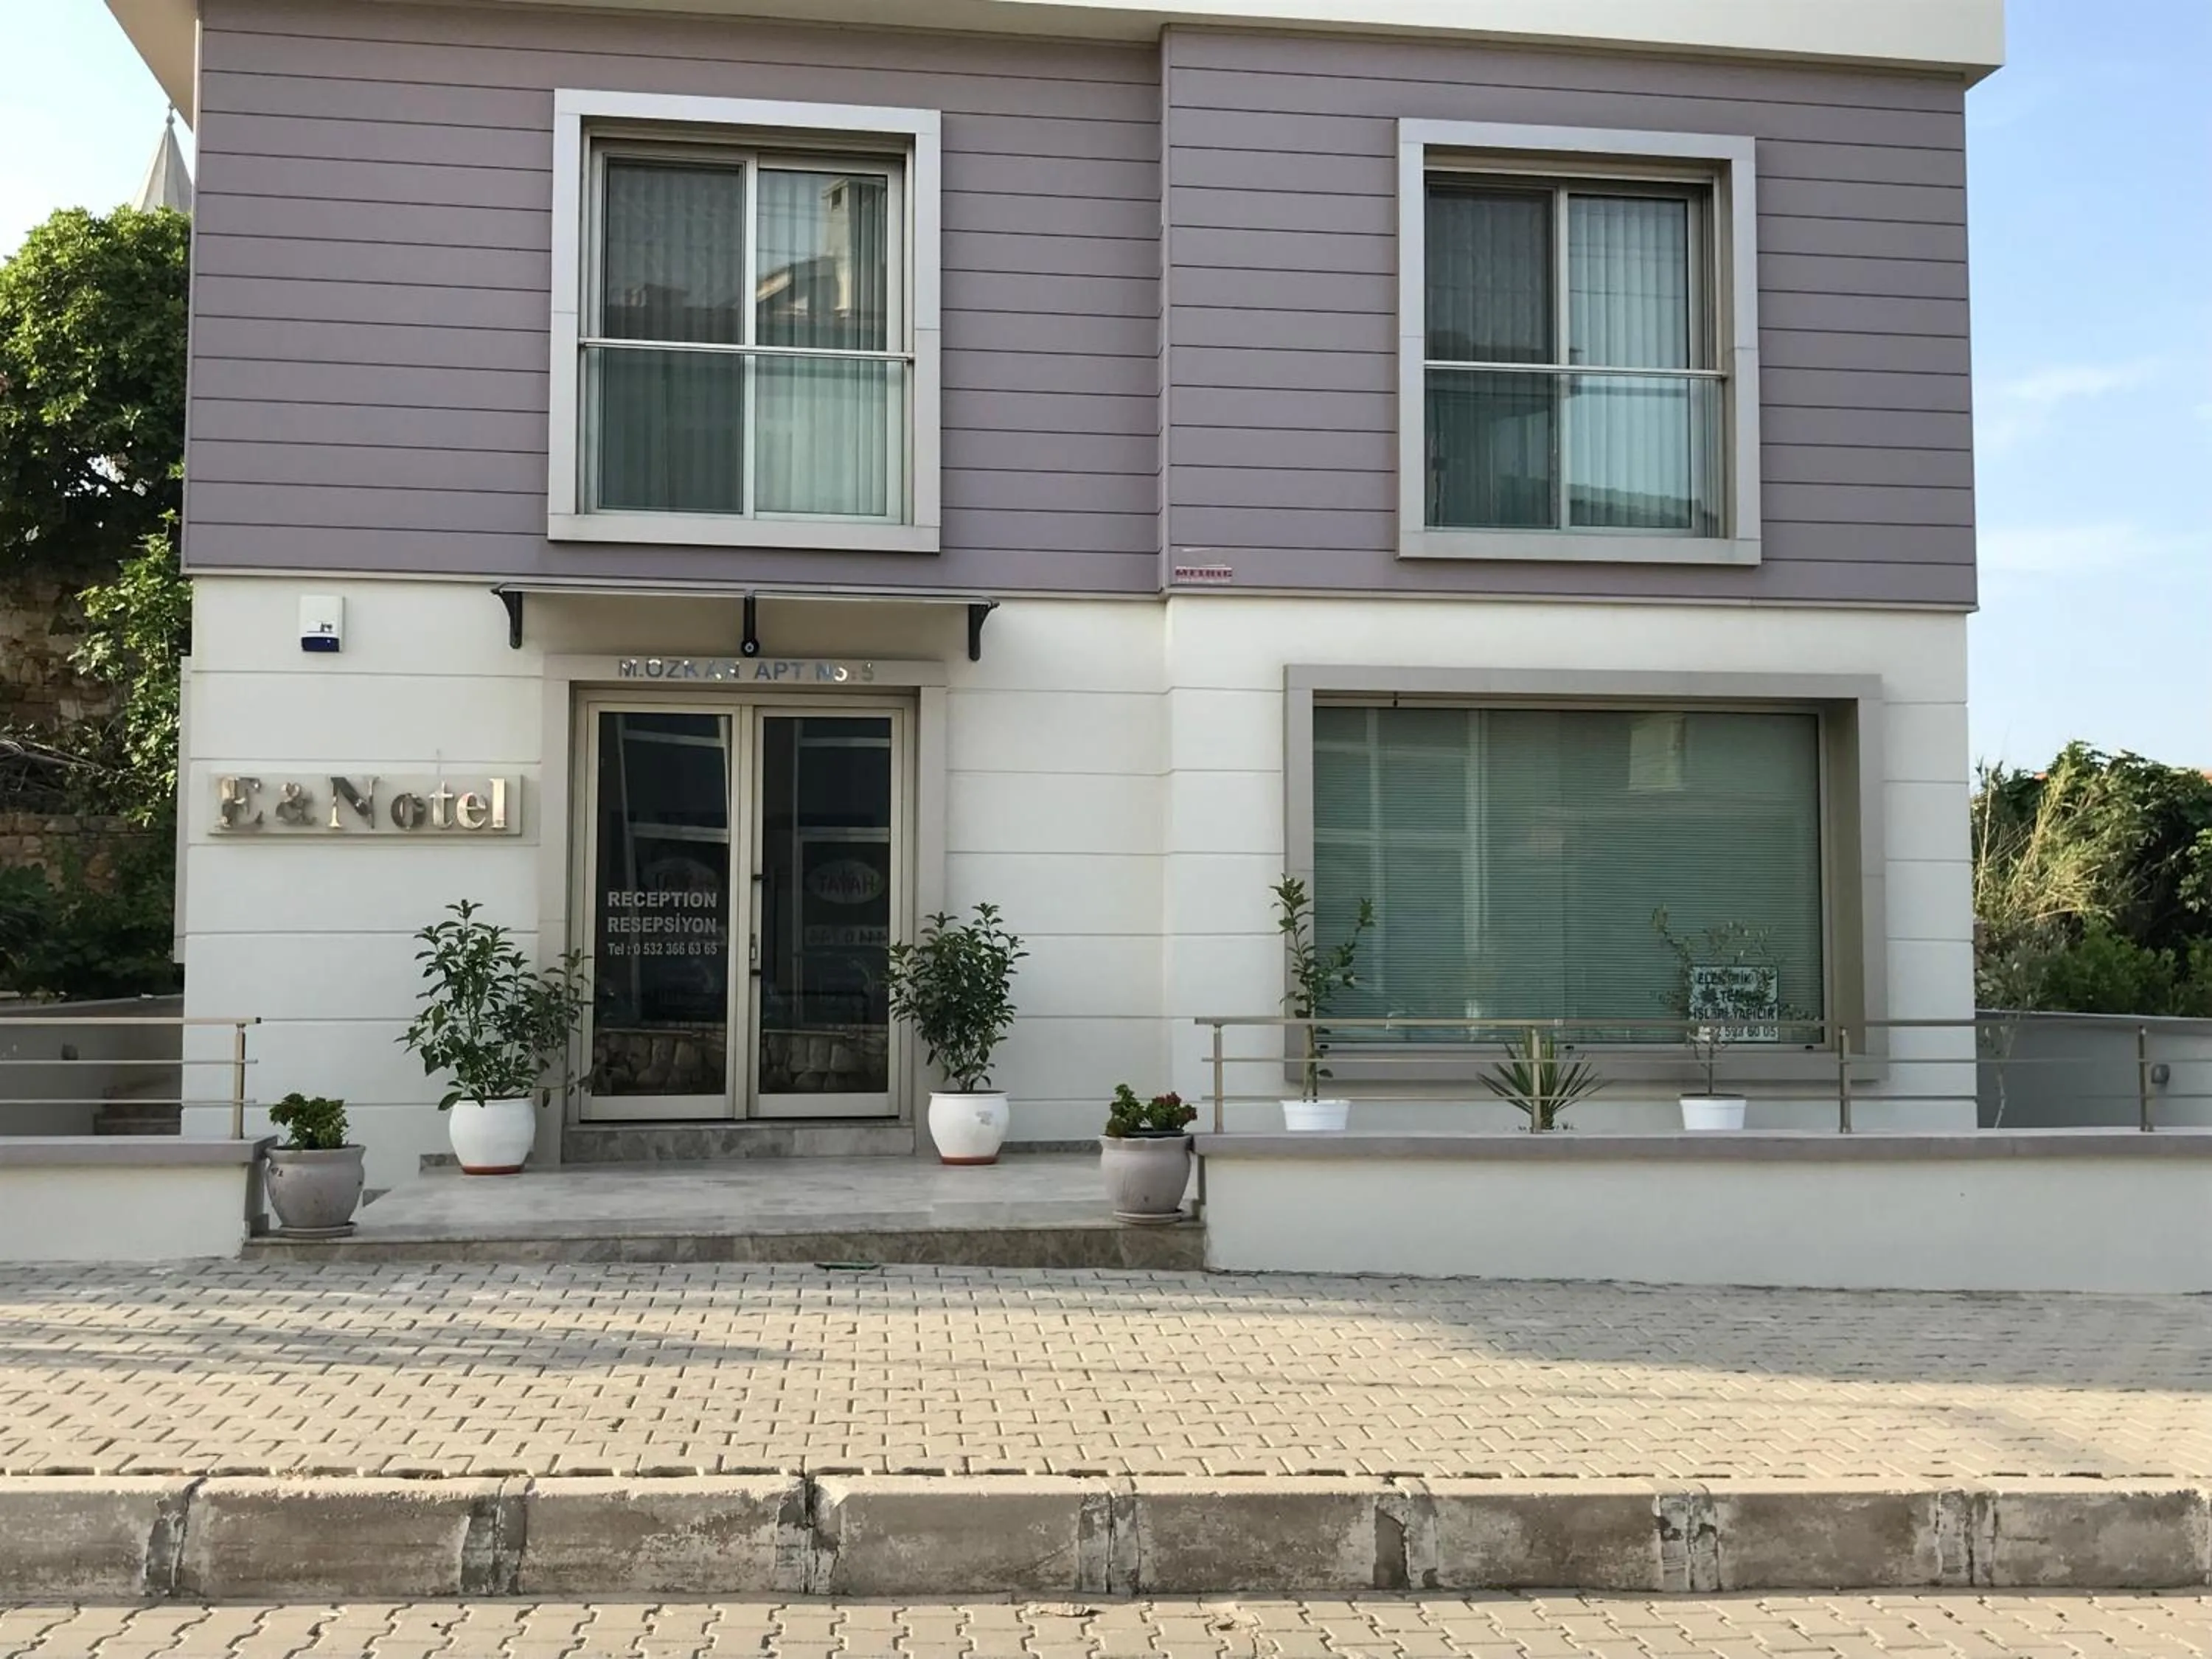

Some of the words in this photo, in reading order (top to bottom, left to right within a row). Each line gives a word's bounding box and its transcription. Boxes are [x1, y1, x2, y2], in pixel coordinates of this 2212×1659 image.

[754, 662, 804, 680] APT
[608, 891, 717, 908] RECEPTION
[608, 913, 717, 933] RESEPSİYON
[643, 943, 663, 955] 532
